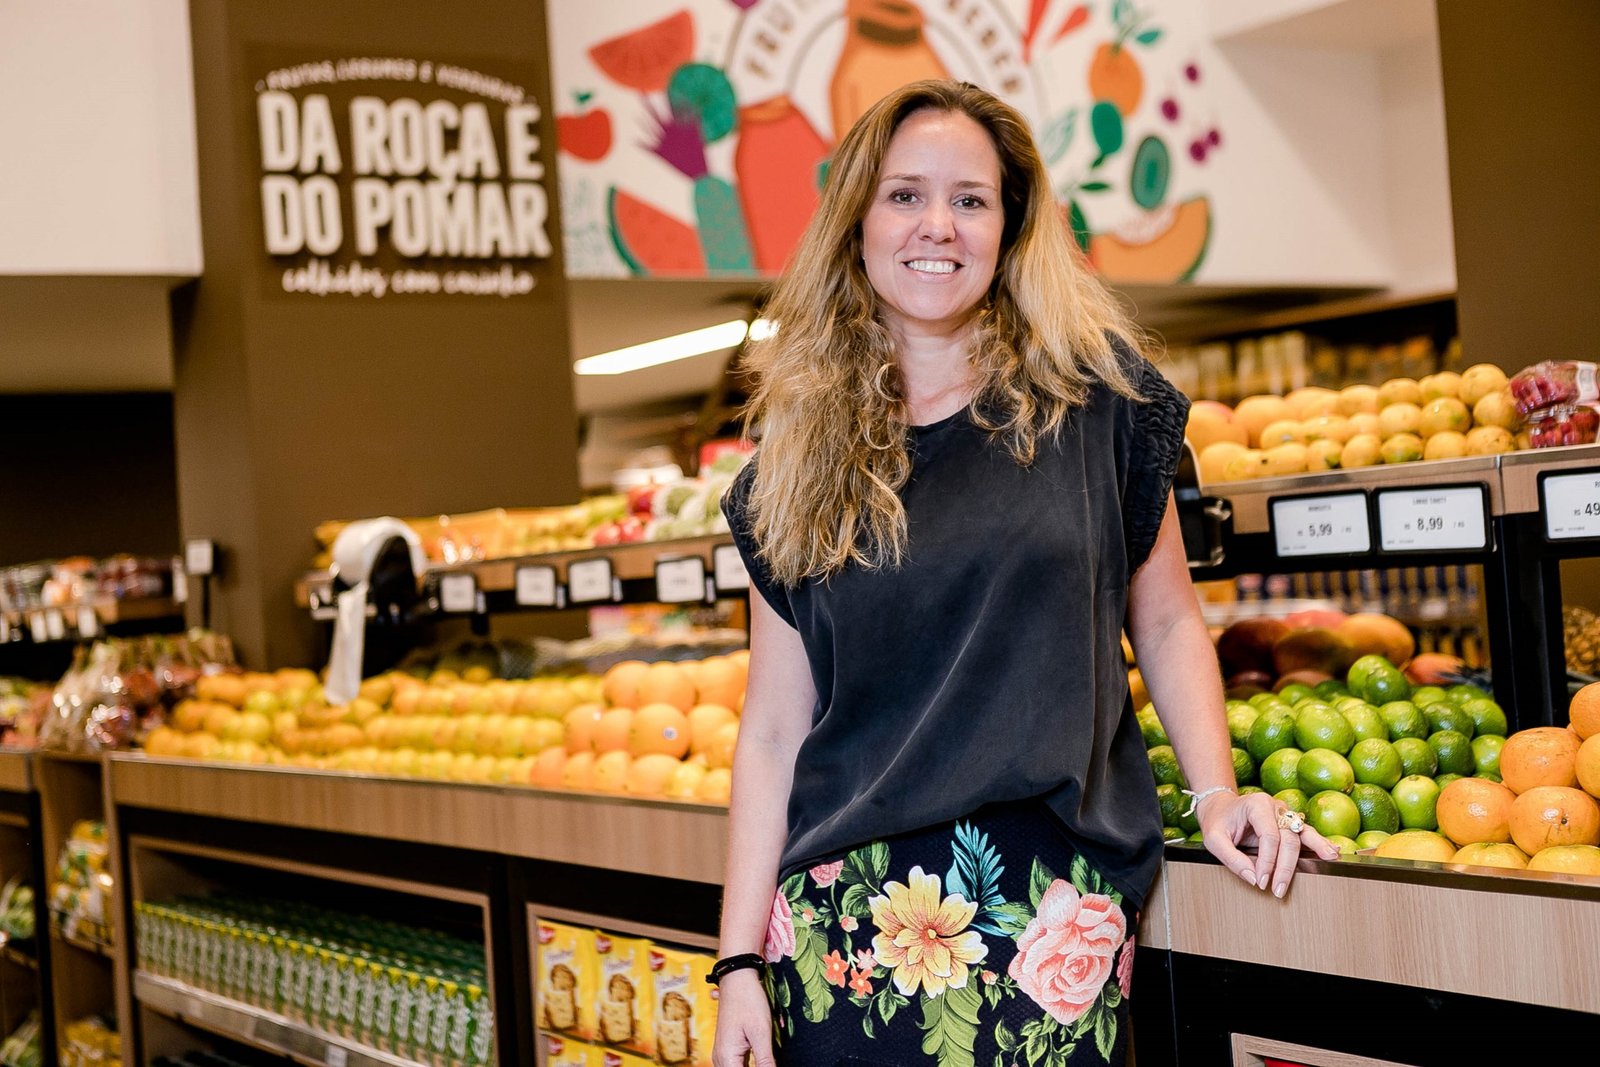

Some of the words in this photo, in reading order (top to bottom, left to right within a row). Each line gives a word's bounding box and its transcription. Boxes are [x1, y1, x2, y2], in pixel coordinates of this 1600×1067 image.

[258, 90, 342, 174] DA
[349, 96, 500, 197] ROÇA
[261, 175, 343, 255] DO
[353, 178, 552, 257] POMAR
[1308, 523, 1333, 537] 5,99
[1417, 517, 1444, 532] 8,99
